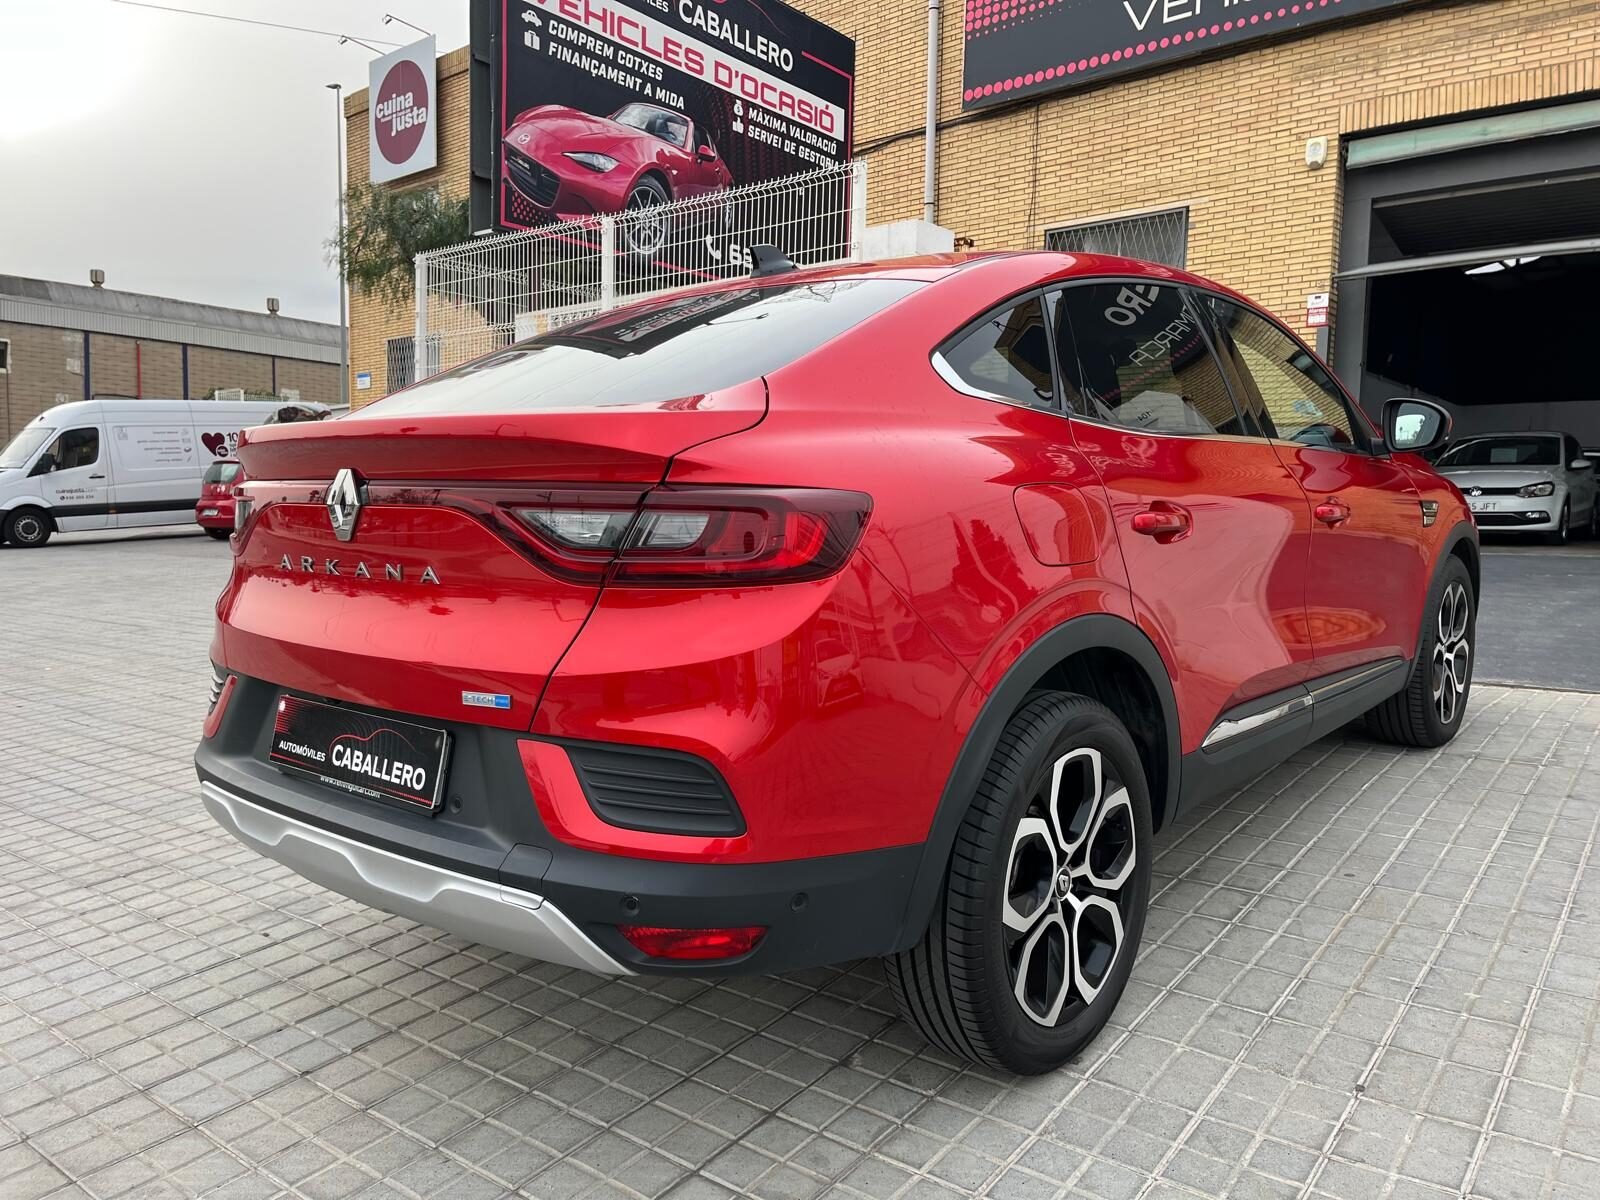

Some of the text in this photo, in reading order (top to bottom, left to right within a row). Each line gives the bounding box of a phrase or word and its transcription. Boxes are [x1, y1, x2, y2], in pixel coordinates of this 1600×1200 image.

[549, 19, 663, 81] COMPREM COTXES
[678, 0, 794, 72] CABALLERO
[537, 0, 834, 134] EHICLES D'OCASIÓ
[548, 41, 685, 110] FINANÇAMENT A MIDA
[376, 91, 413, 119] cuina
[391, 106, 427, 137] justa
[748, 125, 782, 149] SERVEI
[784, 139, 796, 155] DE
[789, 124, 837, 155] VALORACIÓ
[279, 553, 441, 585] ARKANA
[278, 740, 326, 763] AUTOMÓVILES
[331, 744, 426, 791] CABALLERO
